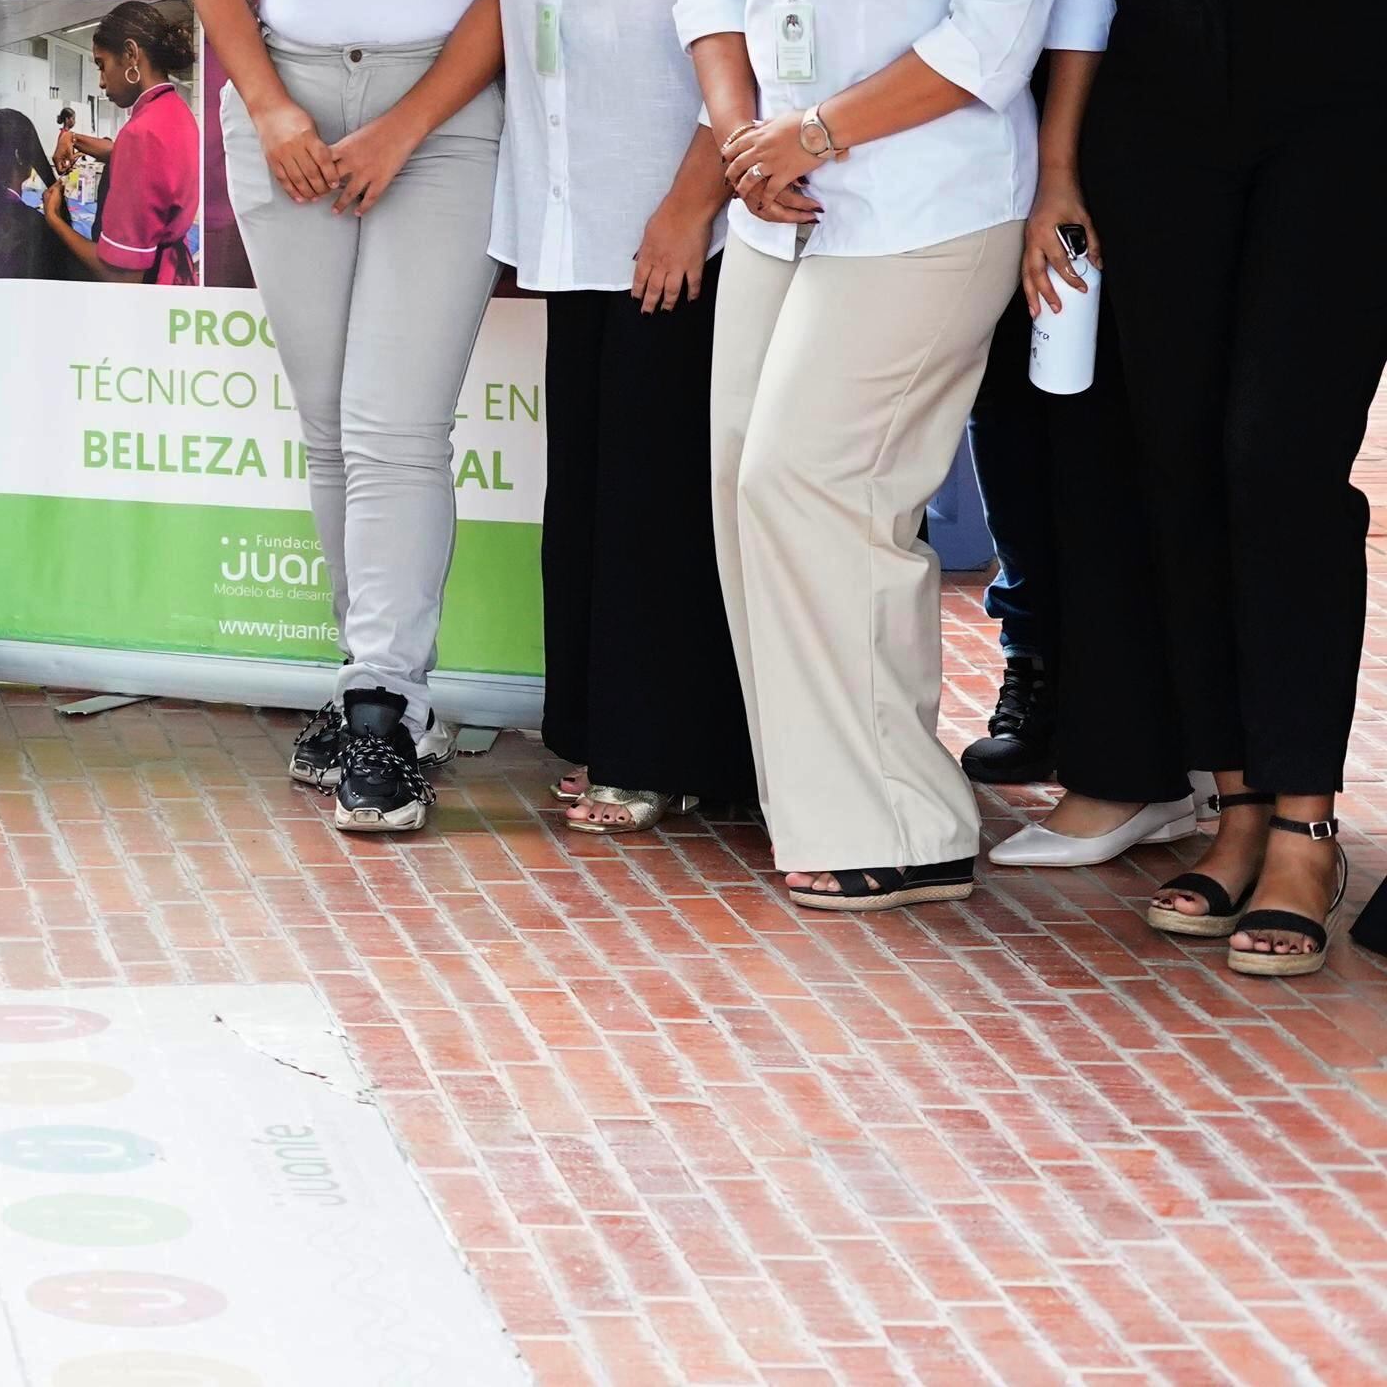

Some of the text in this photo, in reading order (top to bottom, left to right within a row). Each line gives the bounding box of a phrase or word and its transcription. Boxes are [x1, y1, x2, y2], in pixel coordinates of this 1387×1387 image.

[70, 357, 257, 409] TÉCNICO
[485, 382, 540, 423] EN
[83, 429, 268, 478] BELLEZA
[213, 583, 264, 598] Modelo
[266, 586, 283, 599] de
